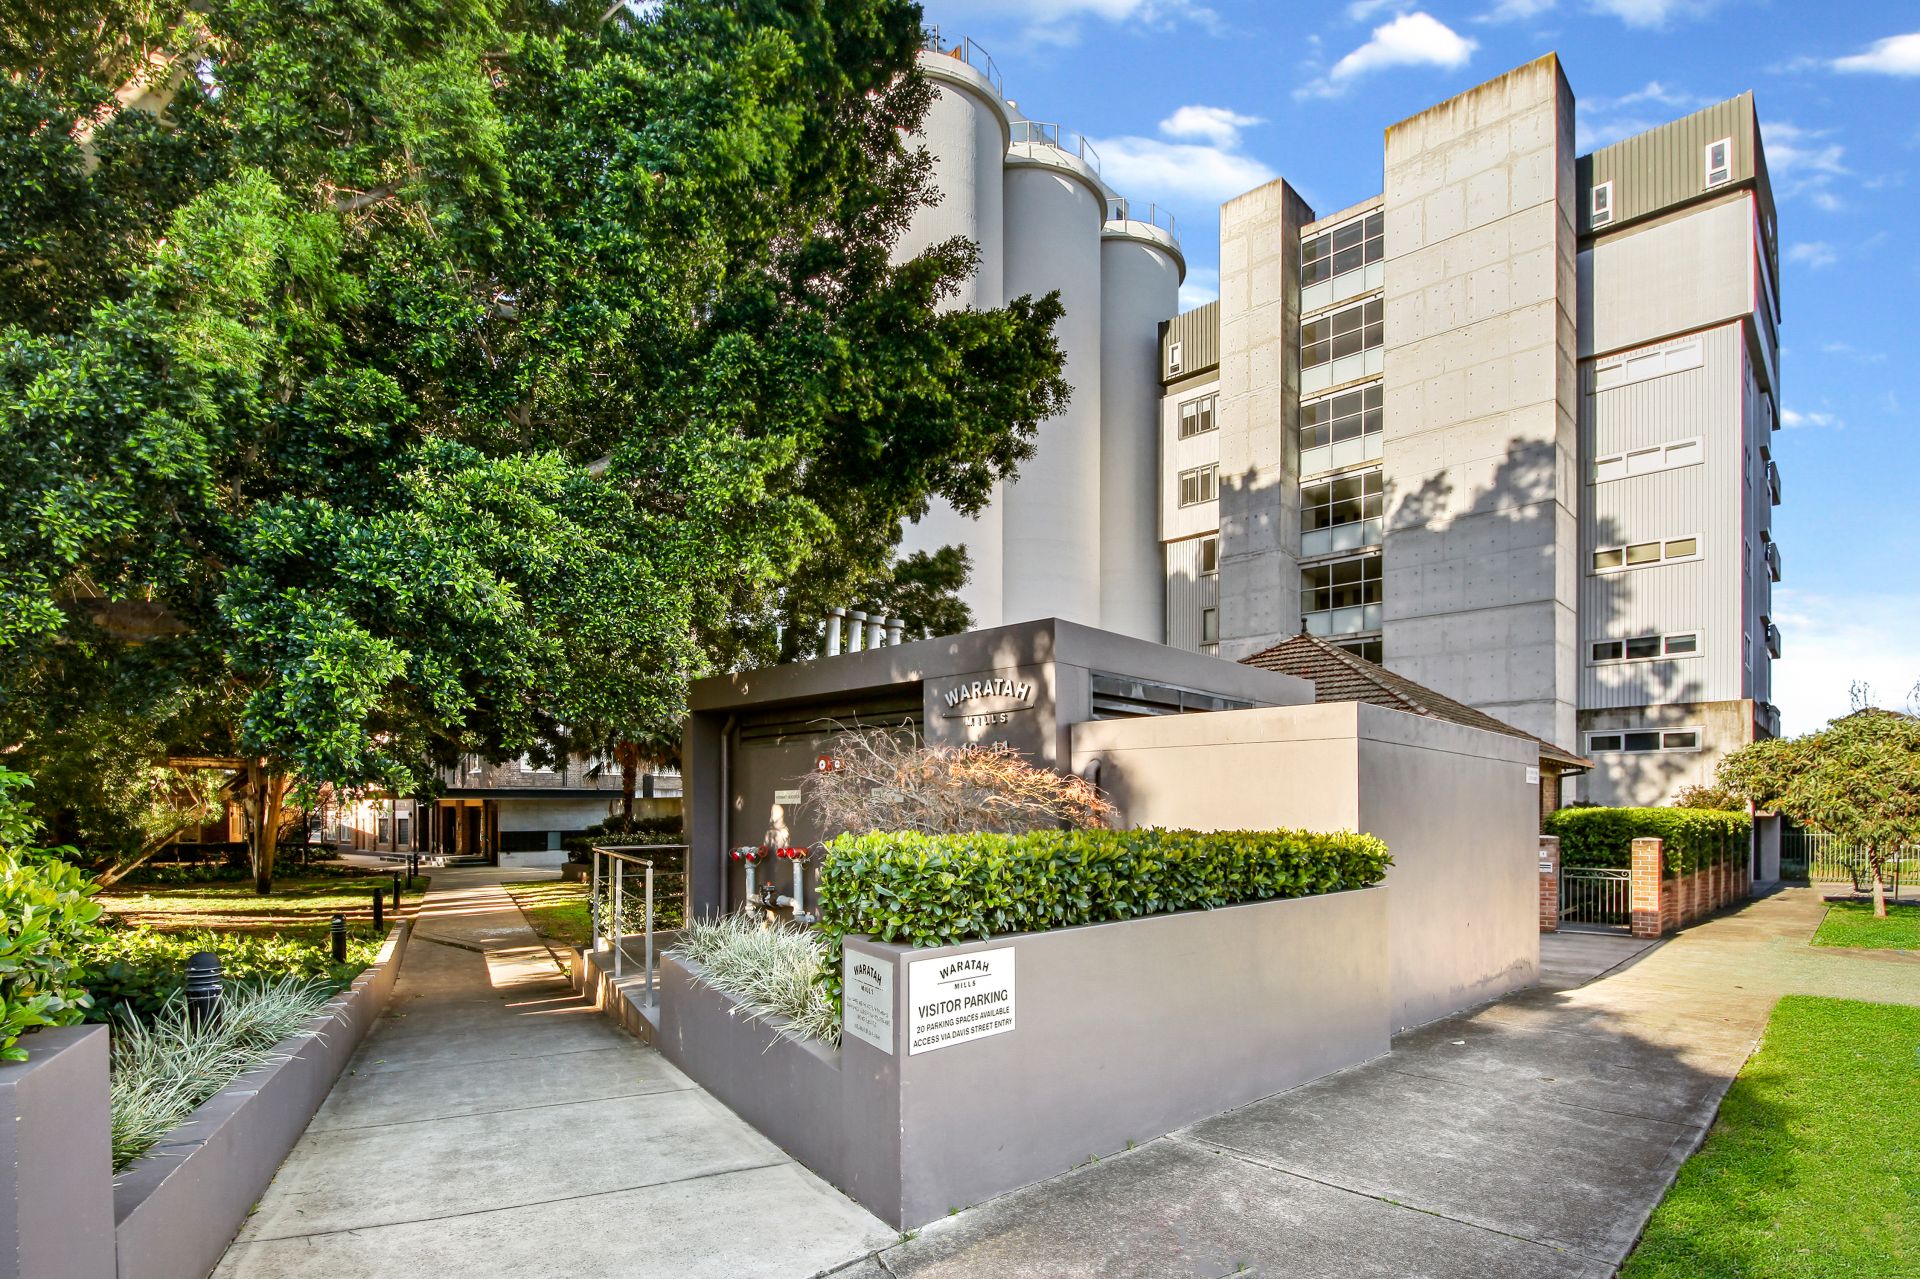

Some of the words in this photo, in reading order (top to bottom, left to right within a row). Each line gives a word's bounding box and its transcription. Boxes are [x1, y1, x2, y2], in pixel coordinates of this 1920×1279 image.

[944, 678, 1031, 707] WARATAH
[965, 713, 1008, 726] MILLS
[854, 963, 882, 986] WARATAH
[939, 959, 989, 979] WARATAH
[954, 980, 976, 990] MILLS
[918, 998, 961, 1018] VISITOR
[964, 989, 1008, 1009] PARKING
[916, 1025, 925, 1034] 20
[926, 1018, 954, 1031] PARKING
[955, 1013, 978, 1025] SPACES
[980, 1006, 1010, 1019] AVAILABLE
[913, 1034, 939, 1048] ACCESS
[941, 1032, 951, 1041] VIA
[952, 1027, 970, 1038] DAVIS
[971, 1022, 993, 1034] STREET
[994, 1018, 1012, 1028] ENTRY
